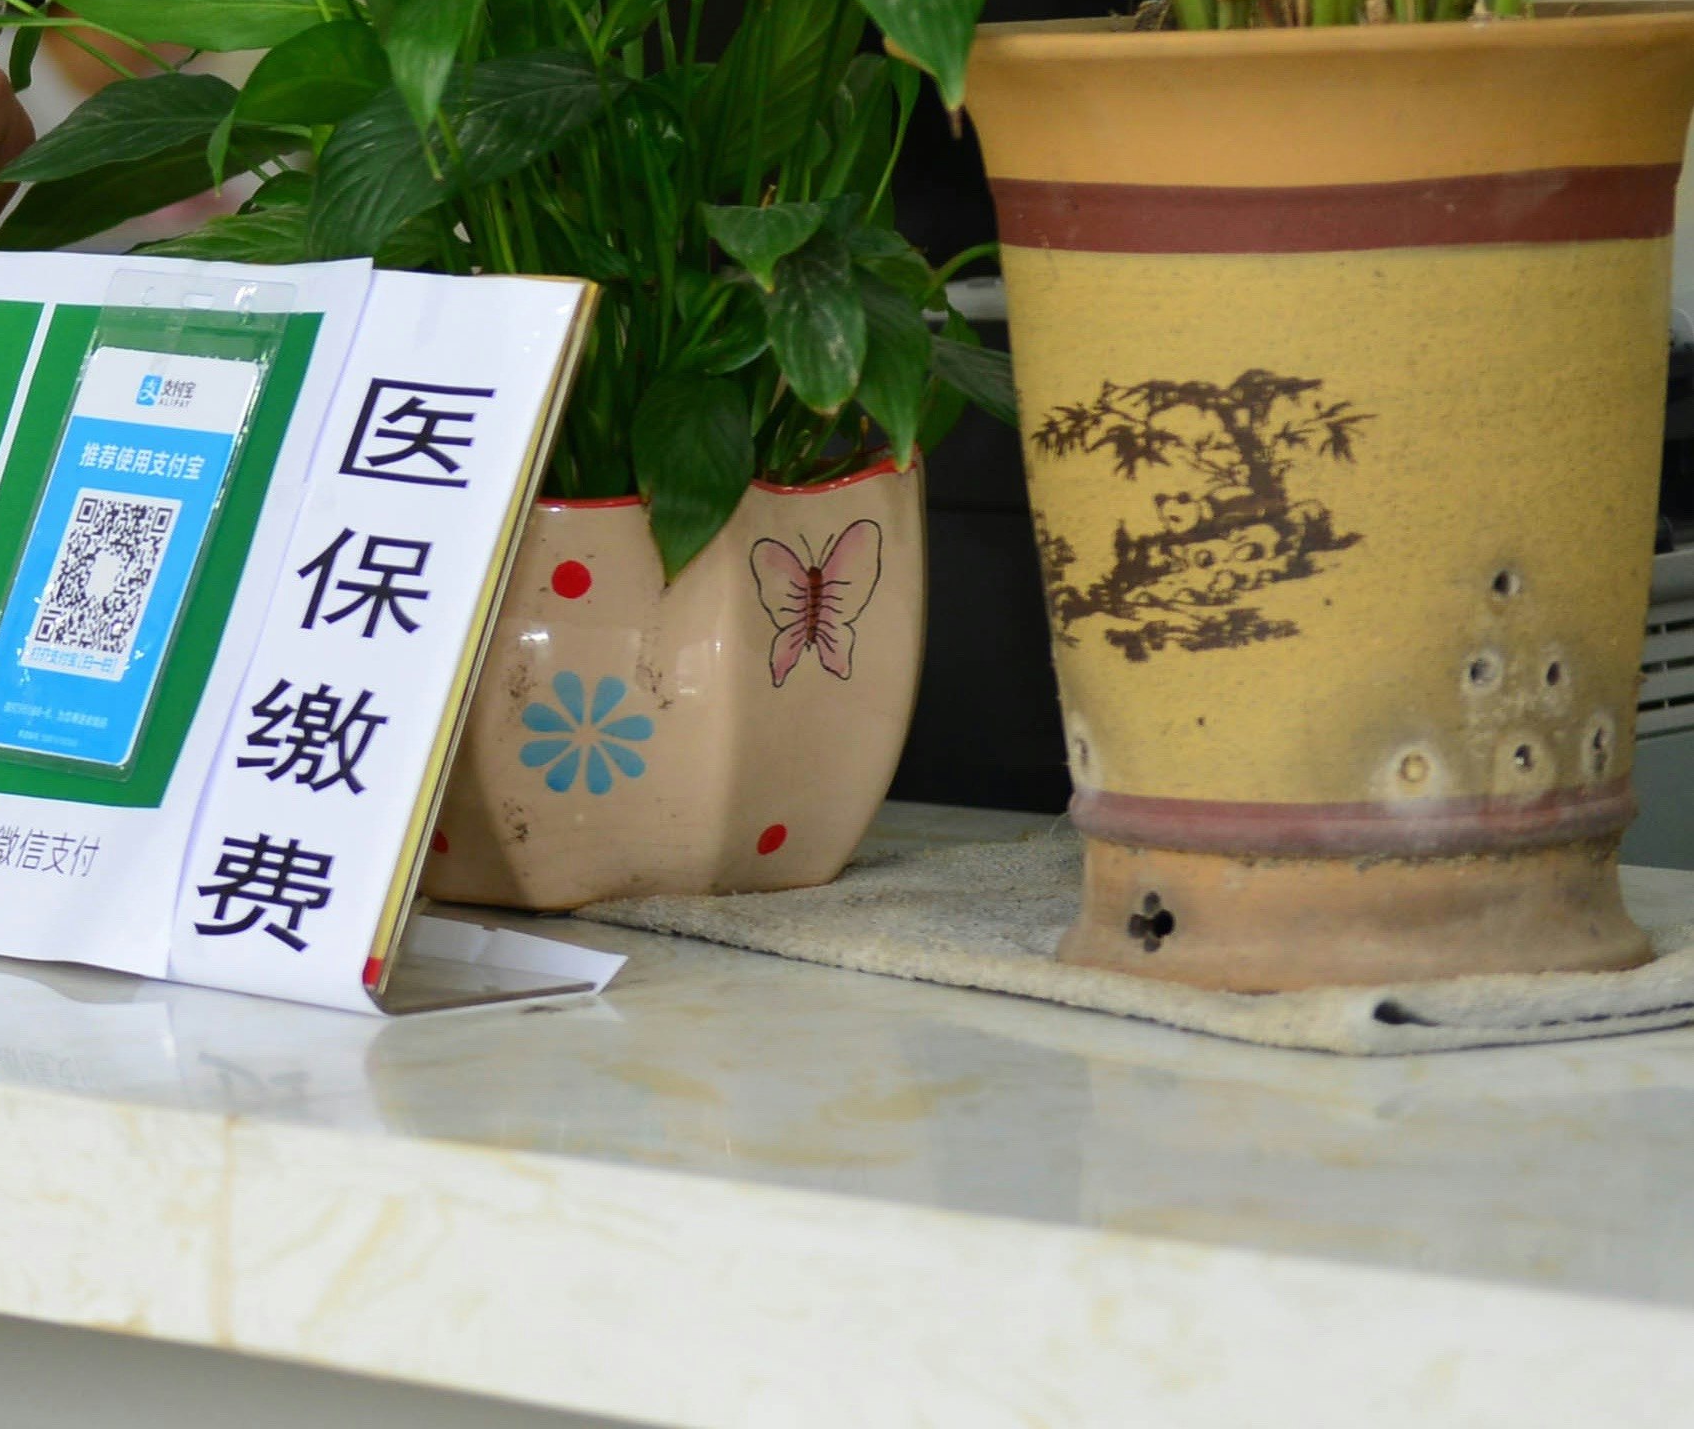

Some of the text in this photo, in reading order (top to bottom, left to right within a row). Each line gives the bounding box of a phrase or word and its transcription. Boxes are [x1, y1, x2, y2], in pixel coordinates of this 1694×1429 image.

[162, 379, 195, 399] 支付宝
[79, 441, 205, 480] 推荐使用支付宝
[194, 377, 497, 953] 医保缴费
